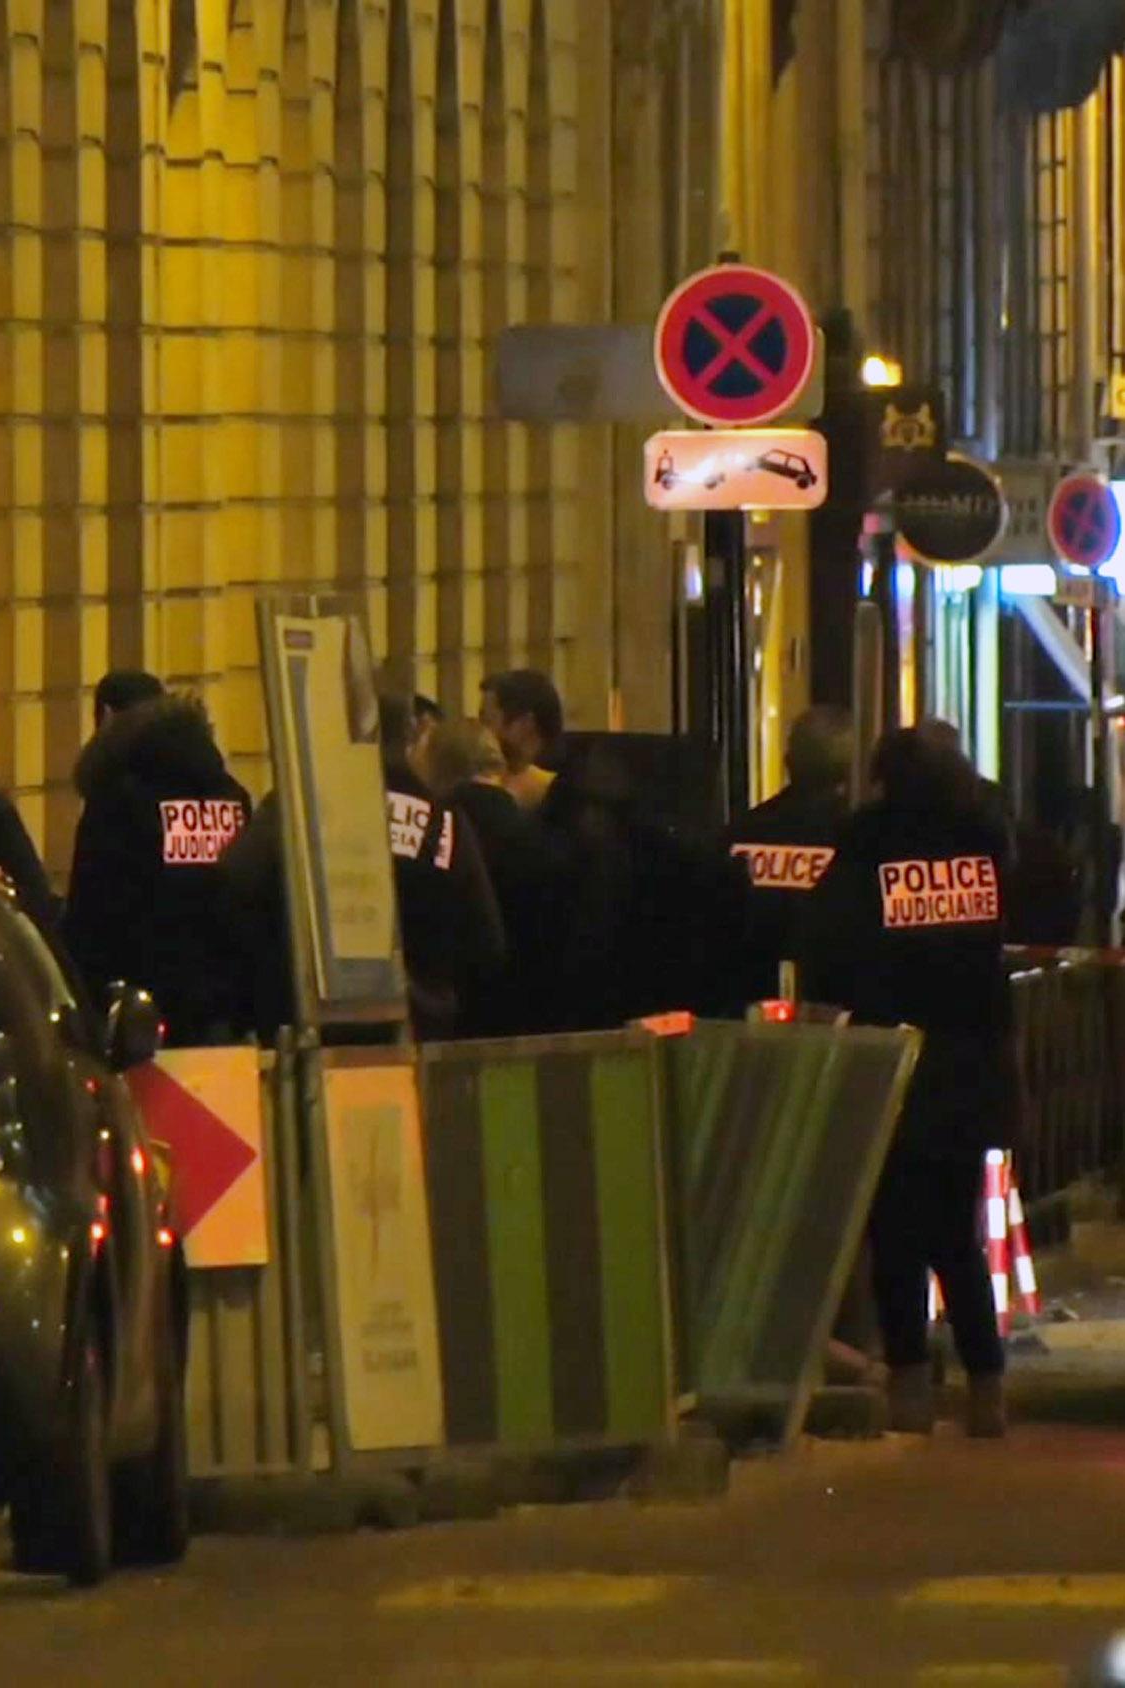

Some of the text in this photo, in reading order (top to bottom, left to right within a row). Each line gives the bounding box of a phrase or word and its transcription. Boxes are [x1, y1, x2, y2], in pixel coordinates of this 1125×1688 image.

[736, 850, 828, 881] OLICE
[883, 859, 994, 895] POLICE
[888, 891, 996, 923] JUDICIAIRE
